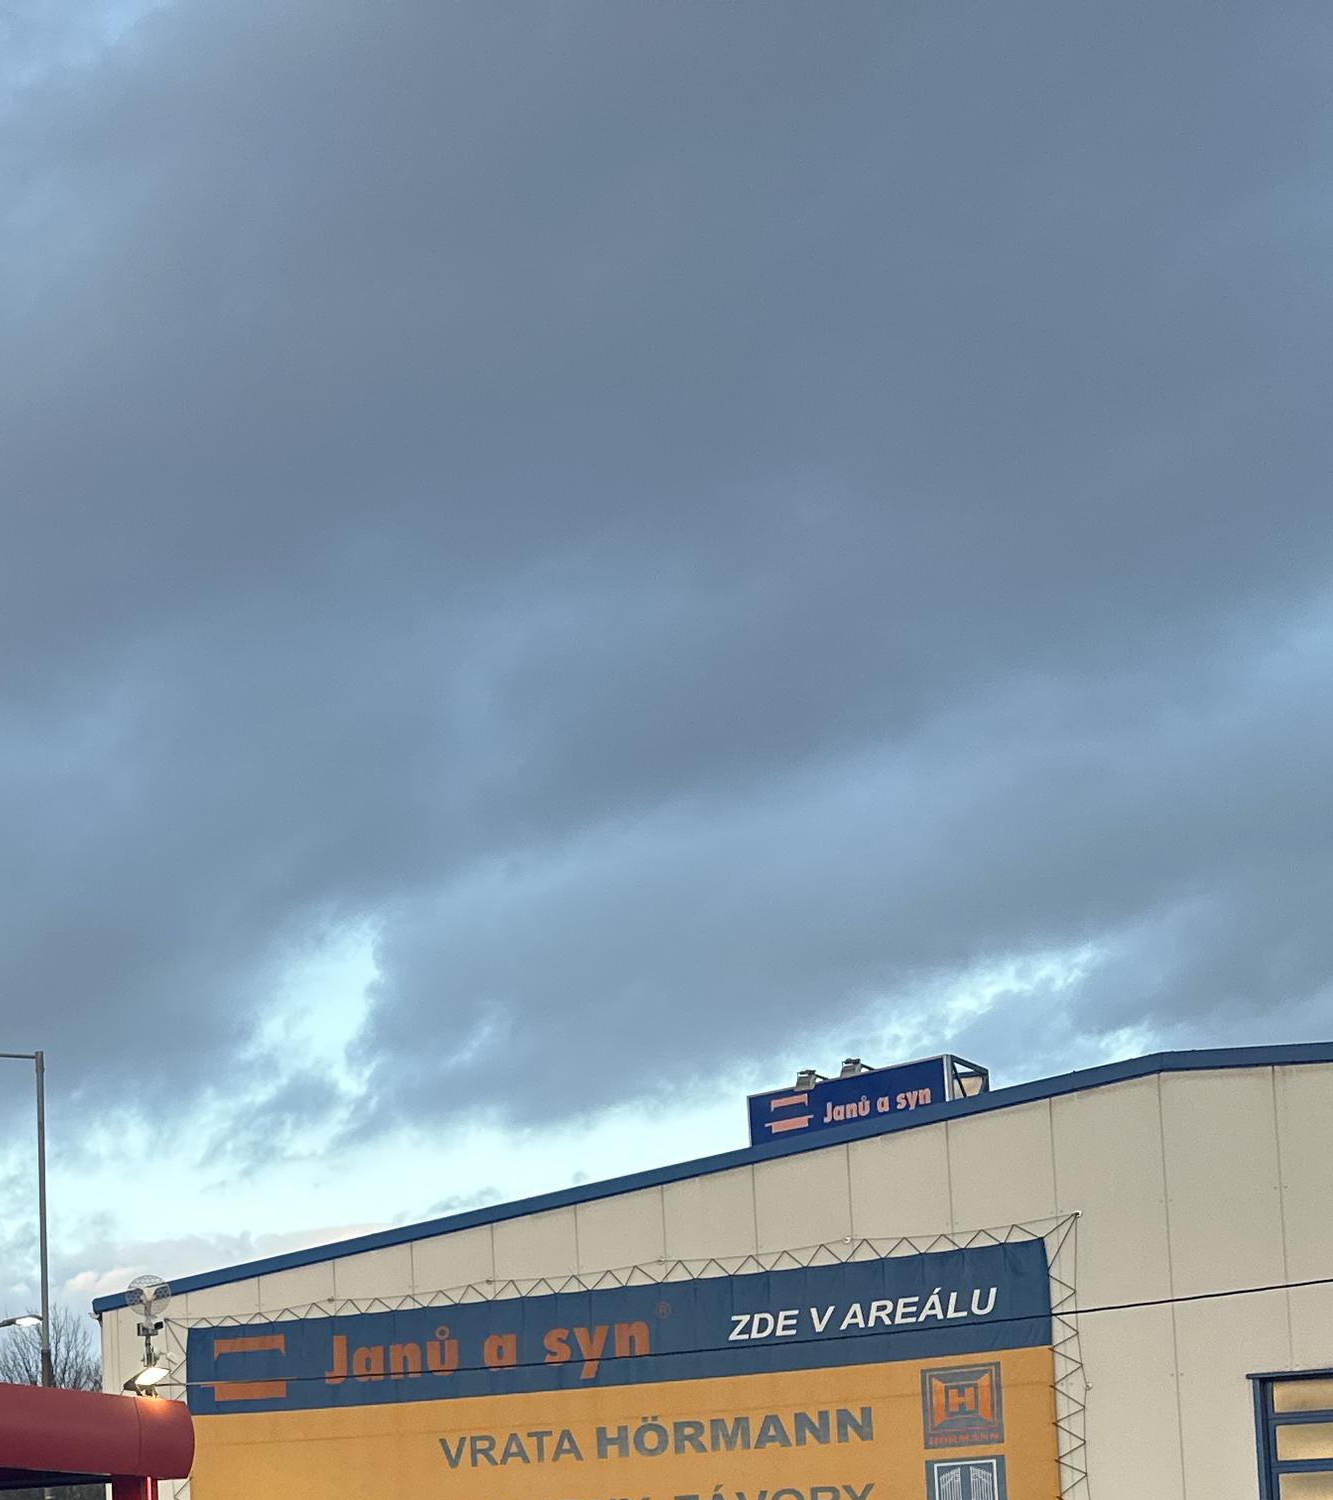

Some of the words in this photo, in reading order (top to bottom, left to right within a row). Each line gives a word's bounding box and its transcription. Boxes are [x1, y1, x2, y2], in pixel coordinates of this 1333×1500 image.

[823, 1096, 871, 1124] Janů
[876, 1096, 890, 1113] a
[896, 1087, 932, 1111] syn
[727, 1309, 800, 1342] ZDE
[810, 1305, 835, 1333] V
[839, 1287, 998, 1331] AREÁLU
[324, 1325, 461, 1385] Janů
[483, 1333, 518, 1372] a
[543, 1319, 652, 1381] syn
[438, 1428, 584, 1470] VRATA
[595, 1406, 874, 1460] HÖRMANN
